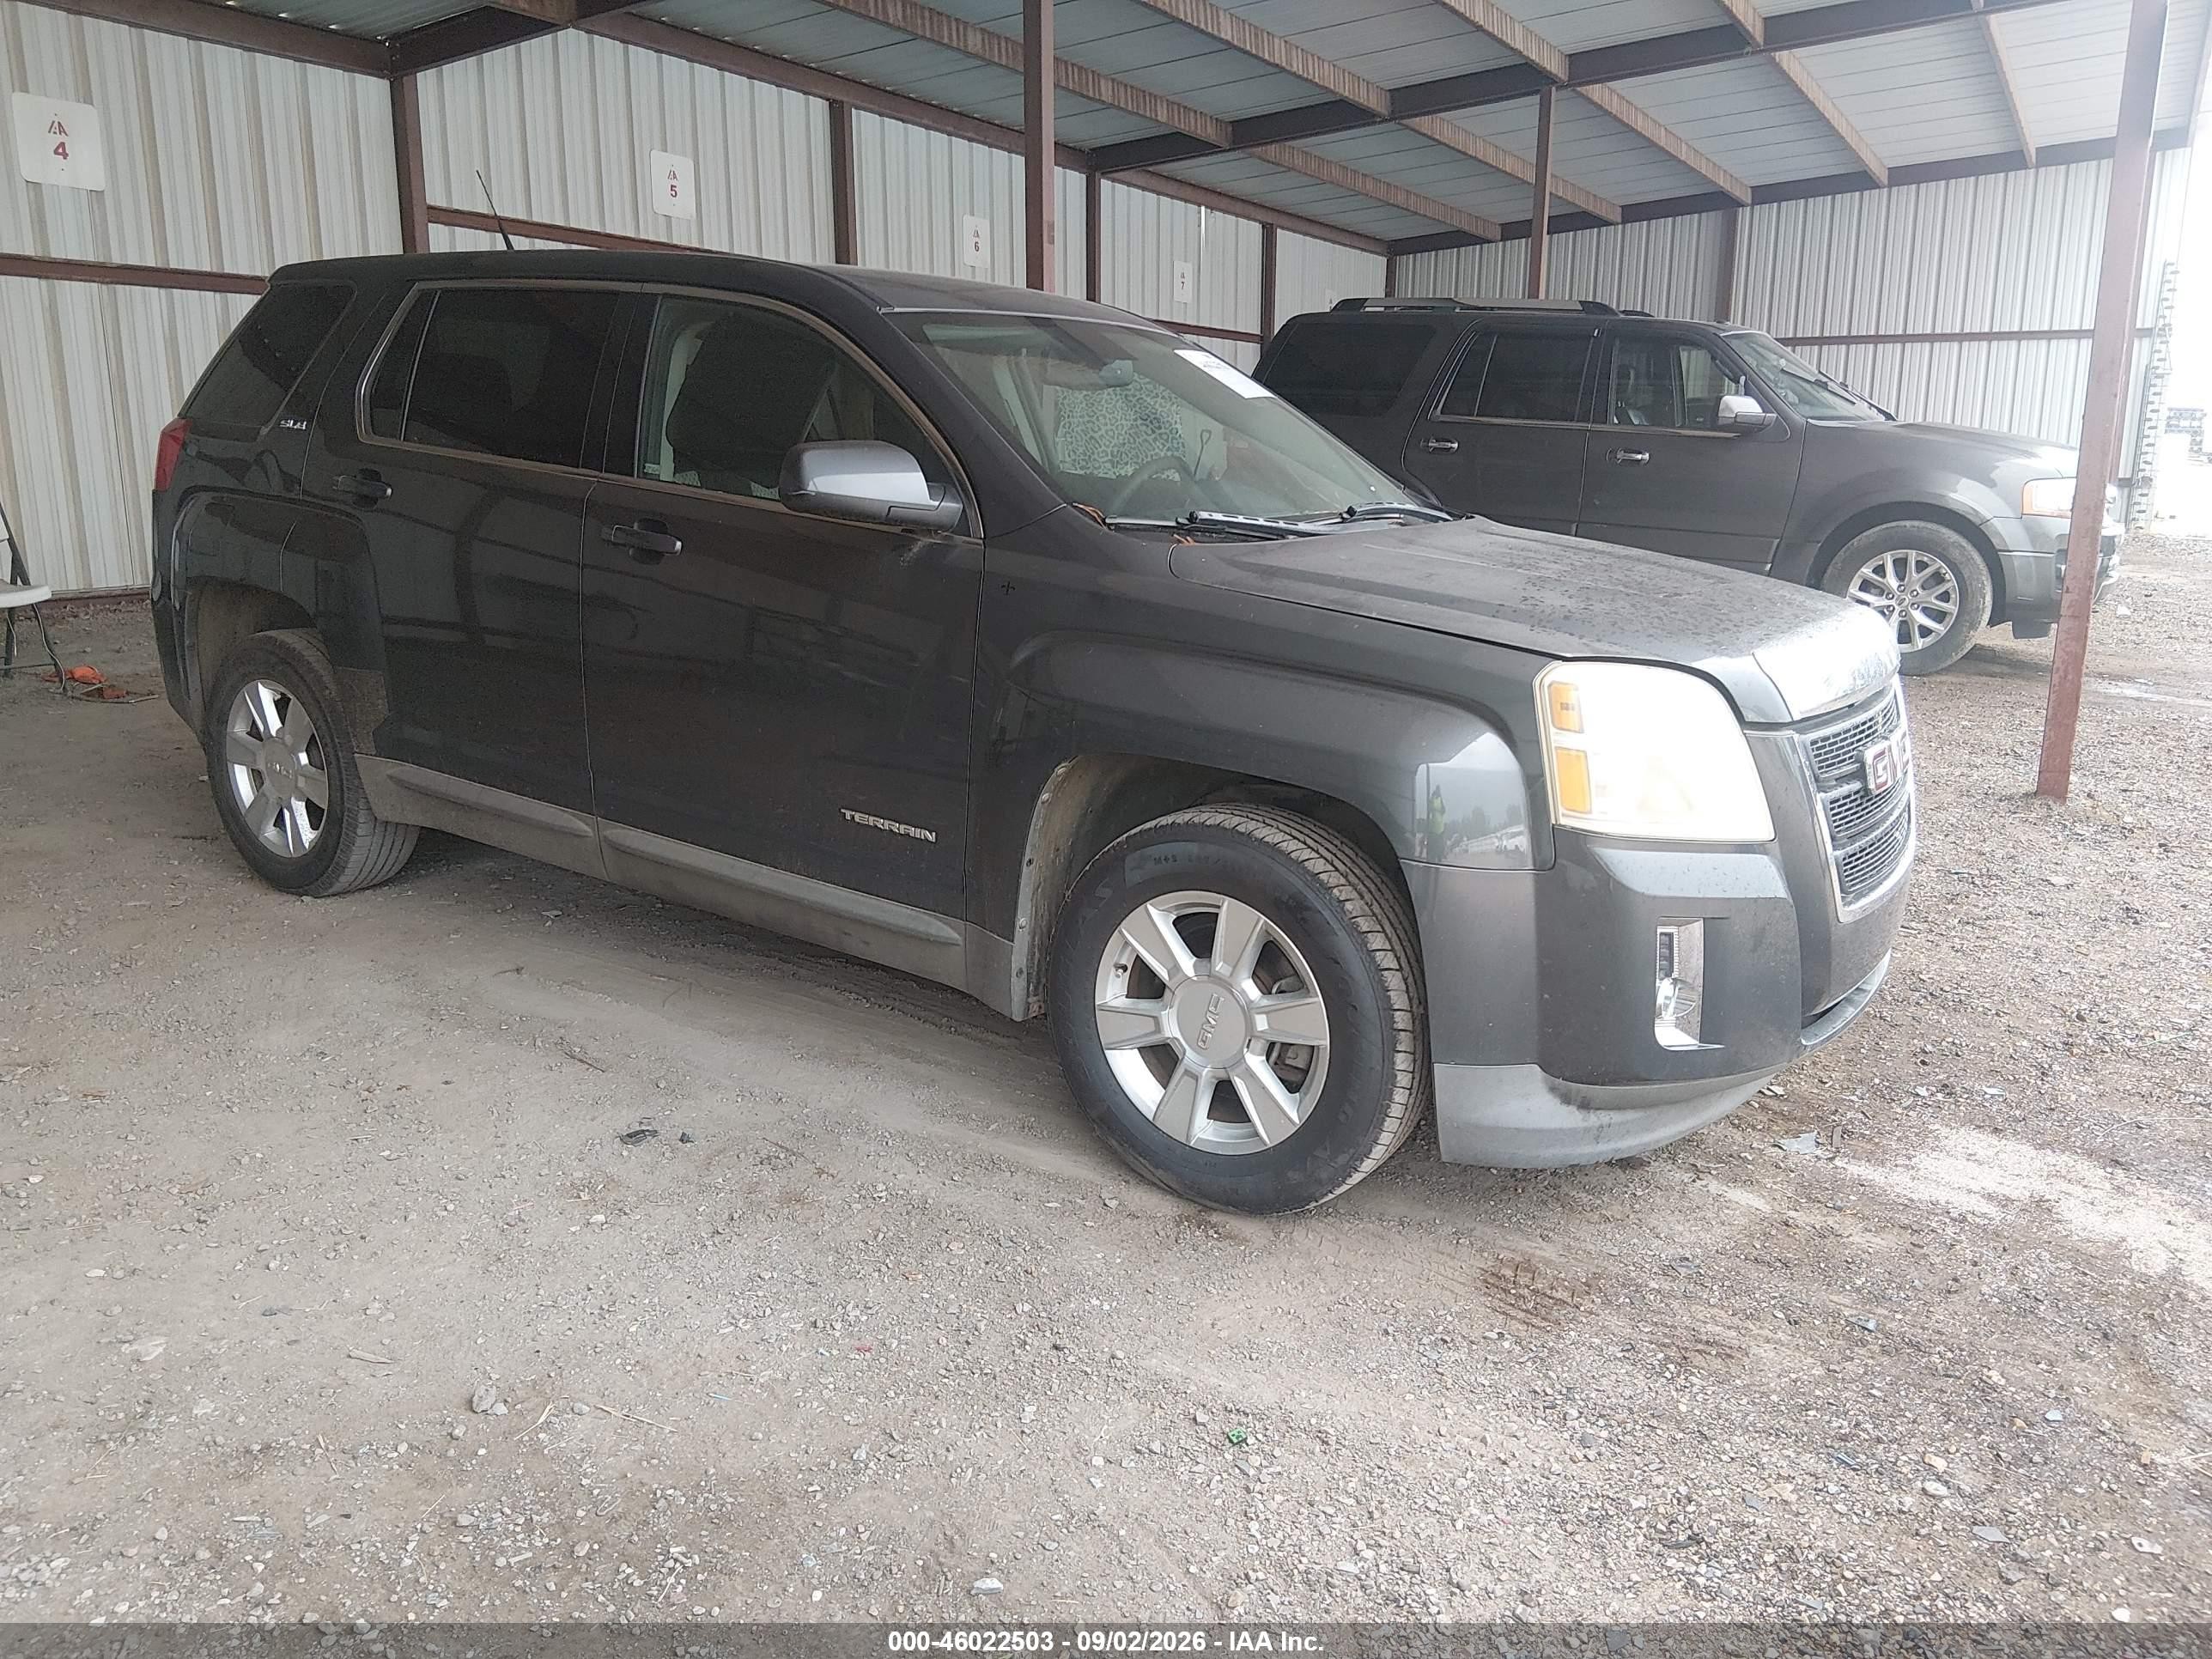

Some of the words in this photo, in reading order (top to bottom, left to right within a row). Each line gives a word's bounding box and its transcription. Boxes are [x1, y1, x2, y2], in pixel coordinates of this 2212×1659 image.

[53, 142, 70, 161] 4
[670, 184, 678, 198] 5
[974, 240, 980, 252] 6
[1181, 281, 1186, 290] 7
[840, 808, 937, 842] TERRAIN
[1196, 993, 1224, 1051] GMC
